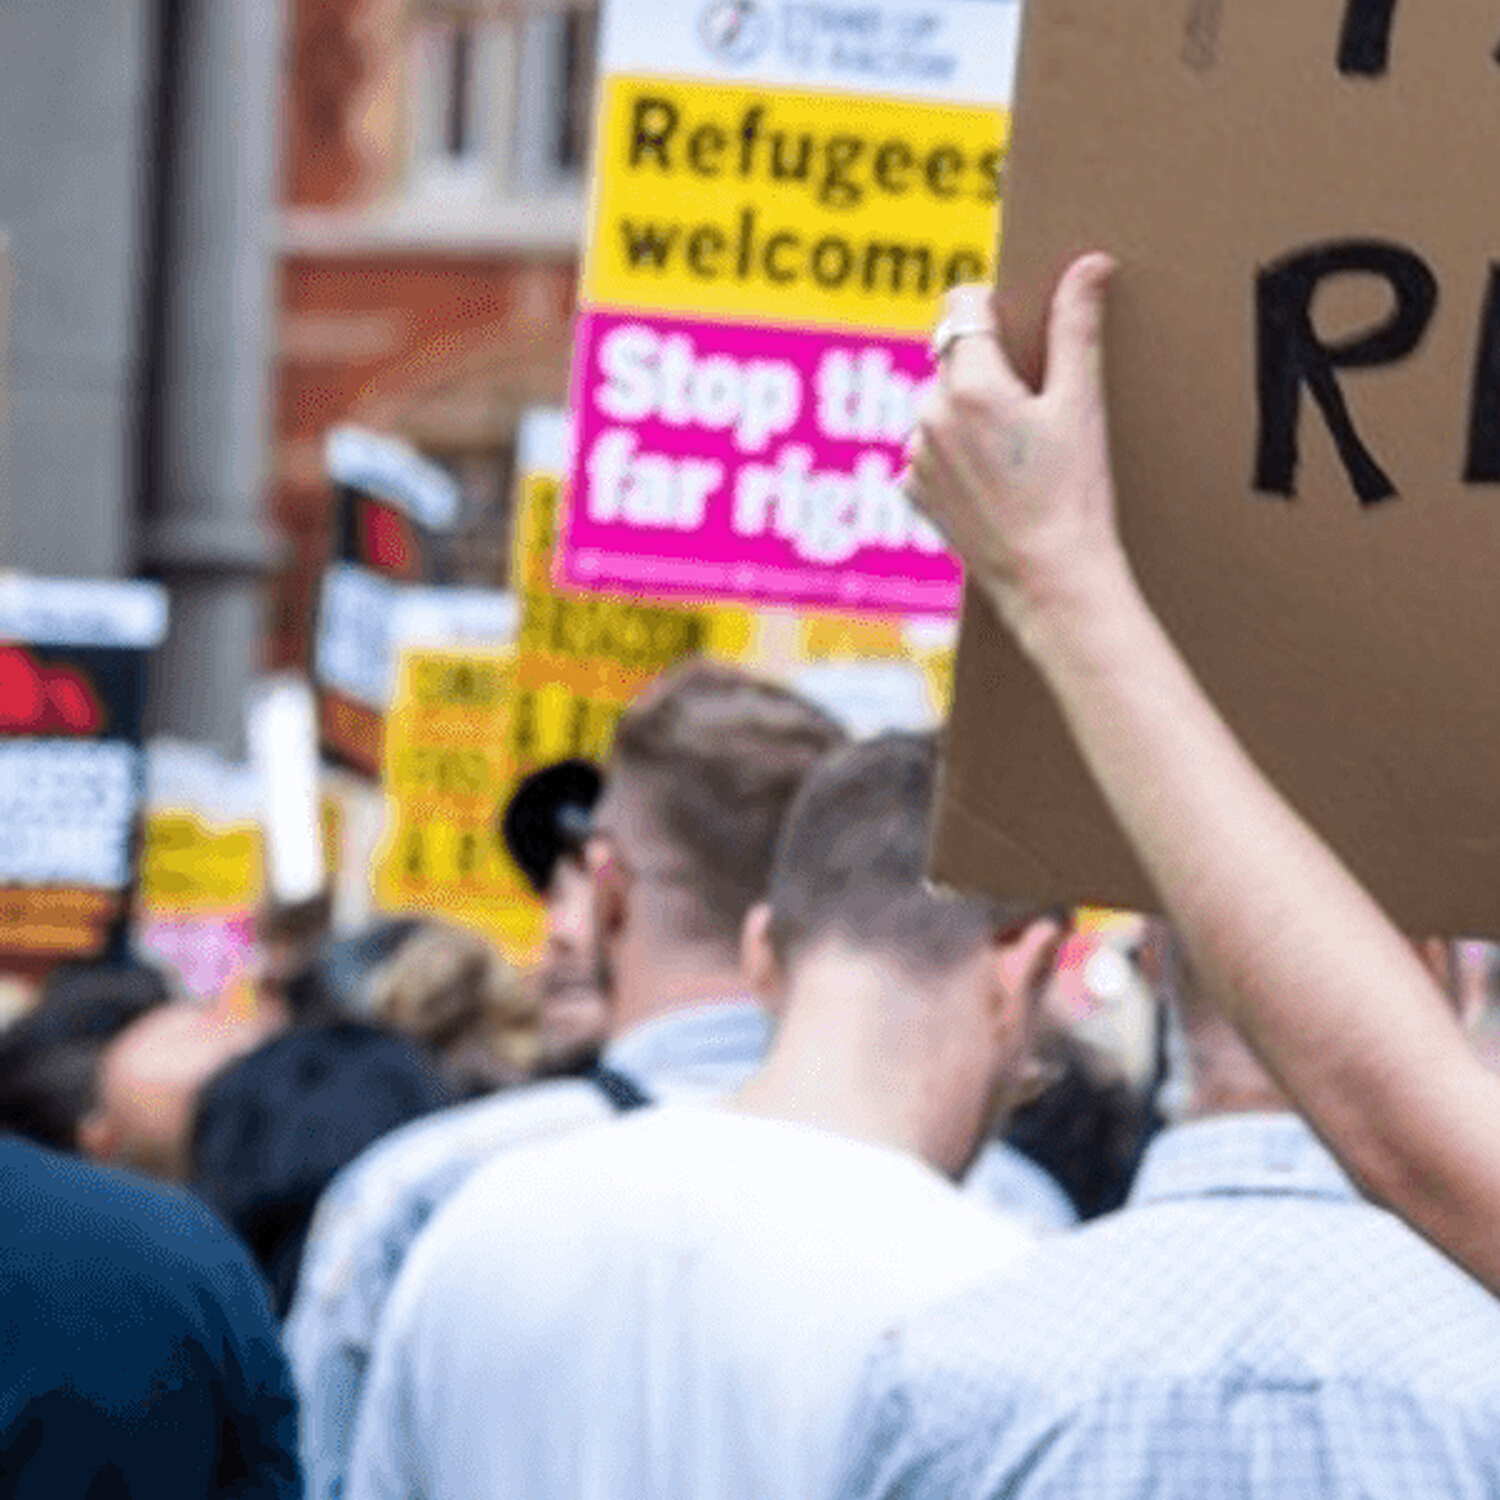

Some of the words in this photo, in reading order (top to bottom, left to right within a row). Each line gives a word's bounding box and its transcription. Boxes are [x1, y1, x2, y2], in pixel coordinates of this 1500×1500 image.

[598, 324, 801, 452] Stop
[815, 350, 938, 443] th
[588, 426, 725, 530] far
